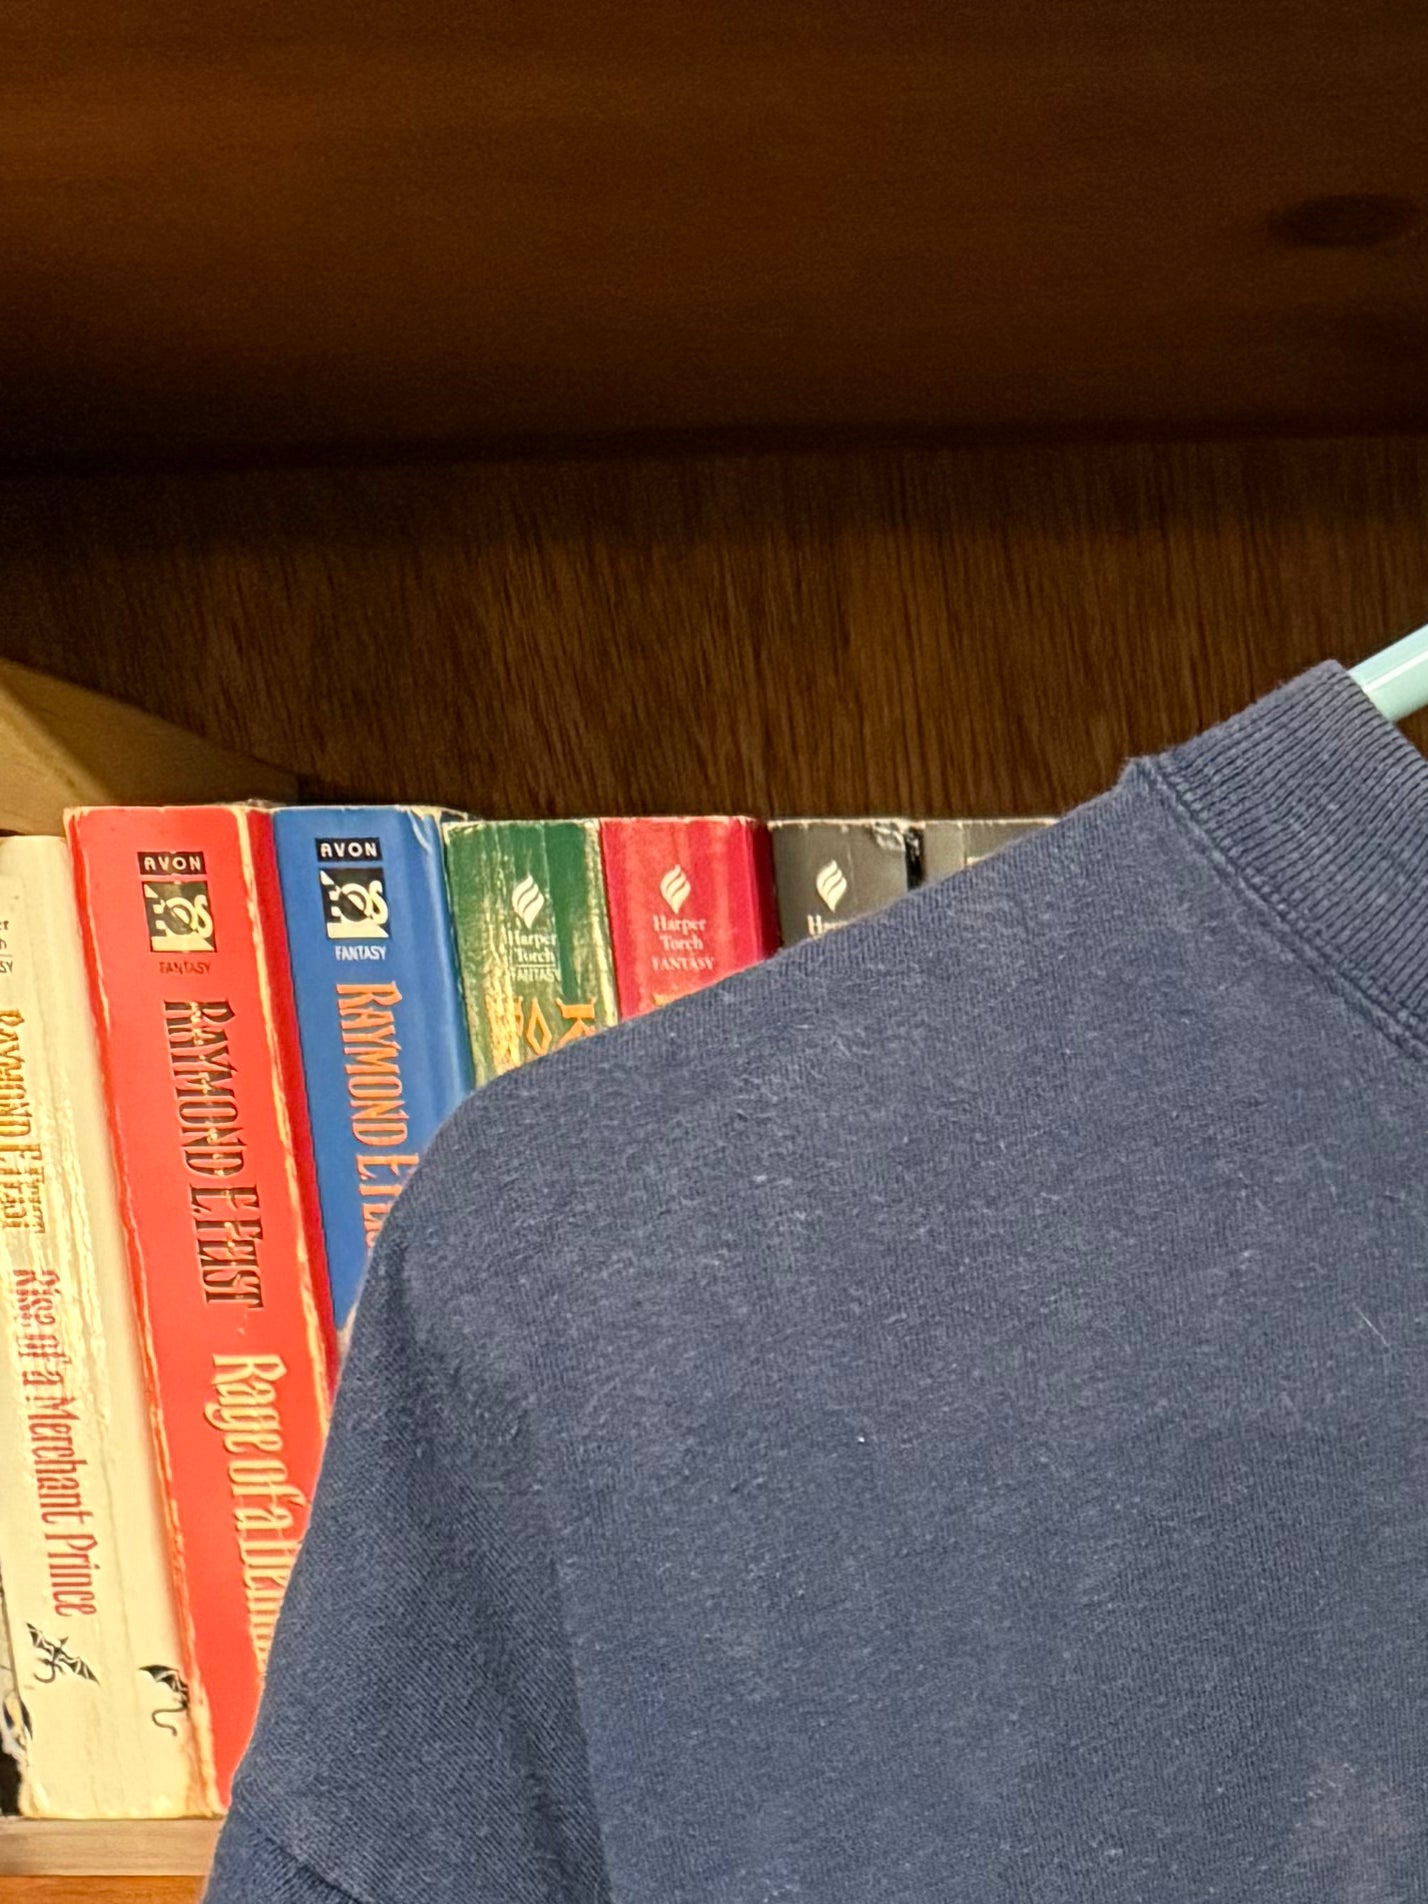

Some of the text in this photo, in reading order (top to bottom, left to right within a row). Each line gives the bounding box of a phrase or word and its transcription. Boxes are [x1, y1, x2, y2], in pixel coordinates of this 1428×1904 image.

[320, 841, 378, 858] AVON
[143, 855, 201, 872] AVON
[653, 916, 706, 934] Harper
[507, 931, 557, 948] Harper
[659, 935, 703, 951] Torch
[336, 946, 386, 961] FANTASY
[516, 948, 556, 963] Torch
[159, 961, 211, 975] FANTASY
[652, 956, 714, 971] FANTASY
[336, 981, 407, 1147] RAYMOND
[164, 1000, 264, 1309] RAYMOND E. FEIST
[23, 1367, 63, 1385] a
[204, 1353, 305, 1532] Rage of a
[27, 1388, 92, 1525] Merchant
[46, 1531, 98, 1617] Prince
